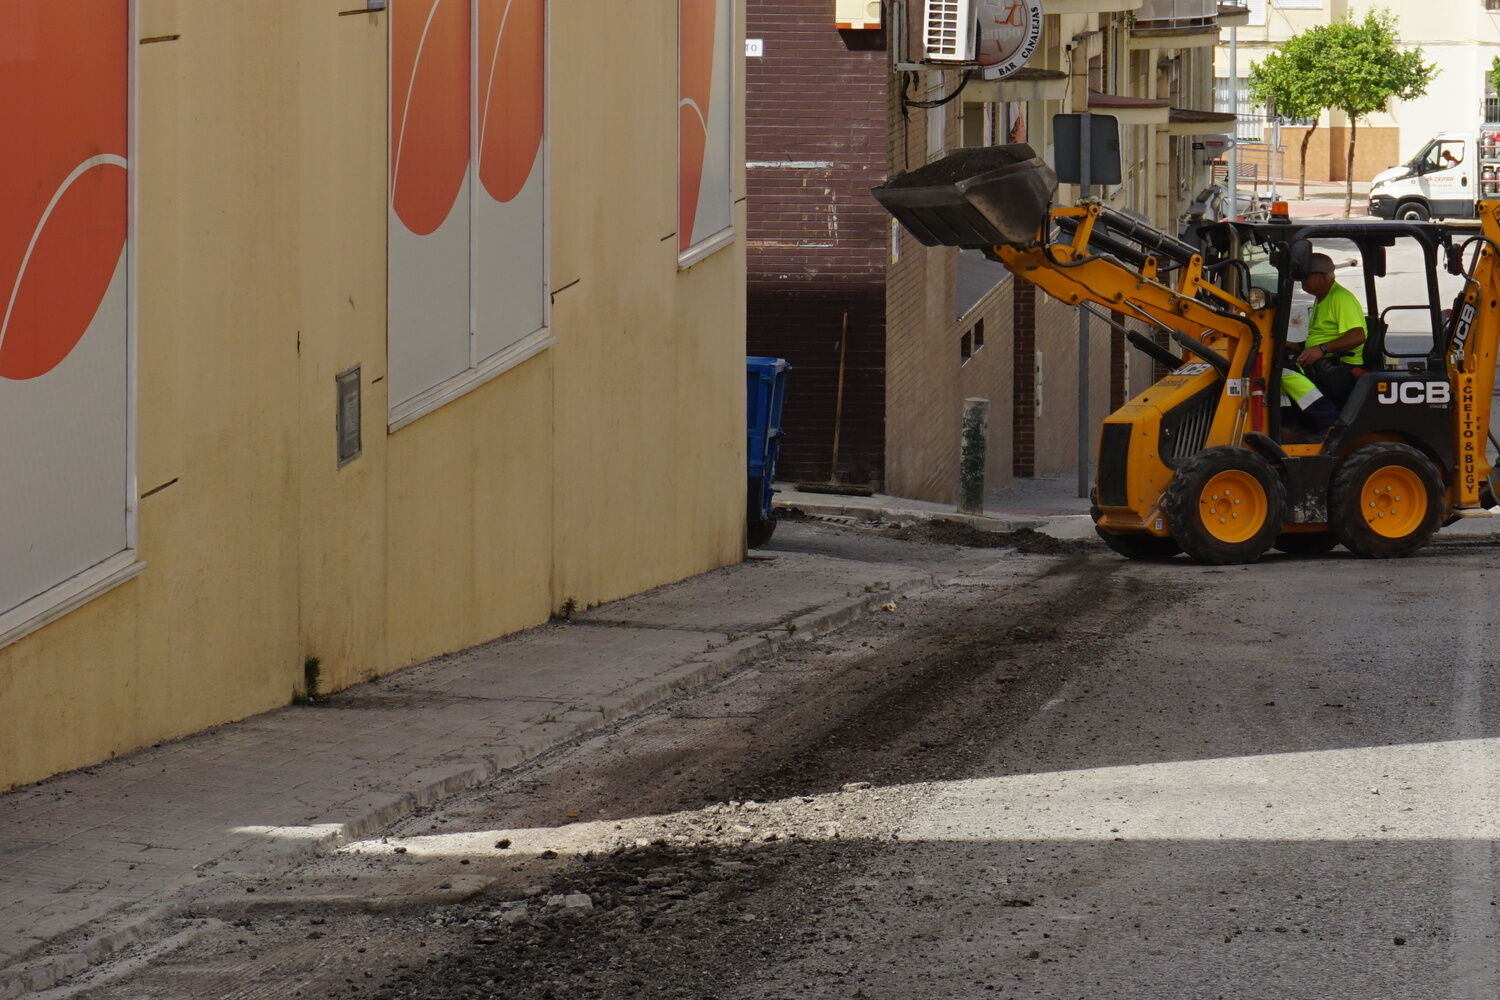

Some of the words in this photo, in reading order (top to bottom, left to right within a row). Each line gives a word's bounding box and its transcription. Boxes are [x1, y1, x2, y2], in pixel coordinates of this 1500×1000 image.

[998, 62, 1017, 76] BAR
[1022, 6, 1039, 59] CANALEJAS
[1453, 303, 1475, 351] JCB
[1377, 381, 1451, 405] JCB
[1463, 386, 1473, 438] CHEITO
[1464, 442, 1474, 451] &
[1464, 455, 1474, 494] BUGY
